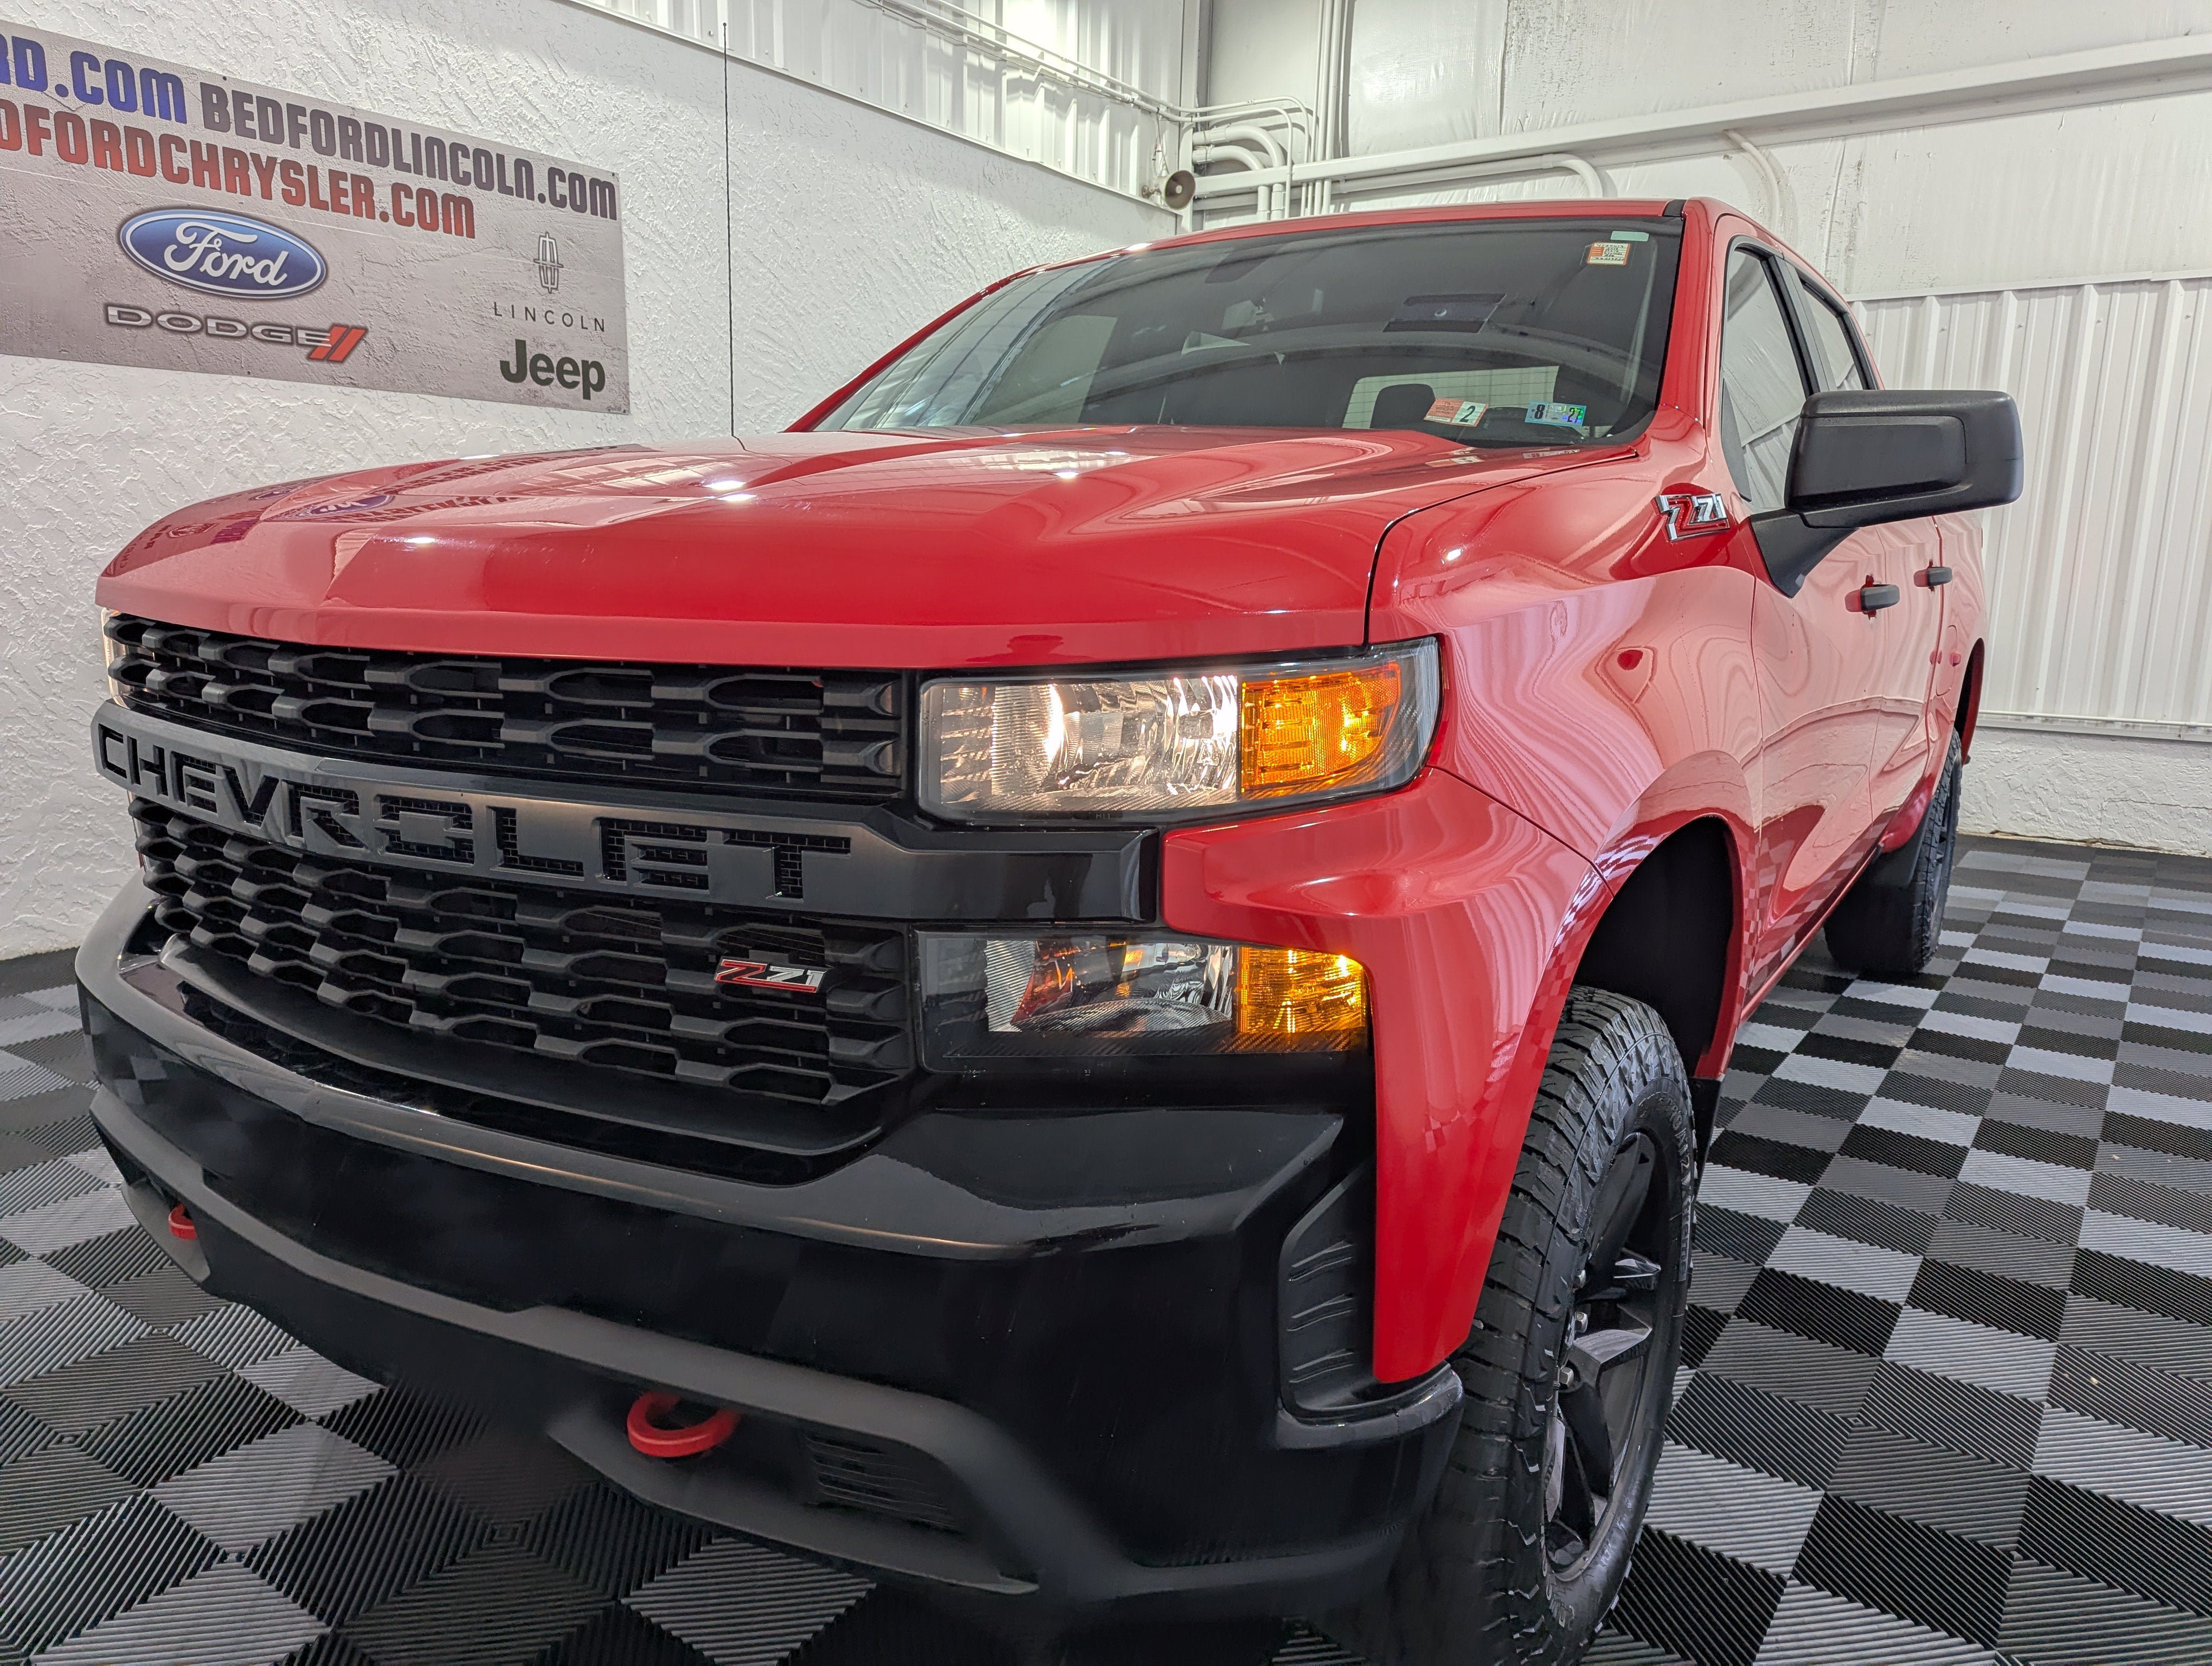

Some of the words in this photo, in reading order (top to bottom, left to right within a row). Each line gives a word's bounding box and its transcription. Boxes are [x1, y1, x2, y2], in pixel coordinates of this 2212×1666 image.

[200, 82, 617, 220] BEDFORDLINCOLN.COM
[164, 222, 288, 287] Ford
[107, 305, 332, 347] DODGE
[493, 301, 606, 333] LINCOLN
[499, 339, 606, 400] Jeep
[1459, 405, 1476, 422] 2
[1534, 404, 1546, 419] 8
[1567, 407, 1582, 423] 27
[1654, 493, 1731, 543] Z71
[98, 723, 852, 902] CHEVROLET
[715, 959, 828, 994] Z71
